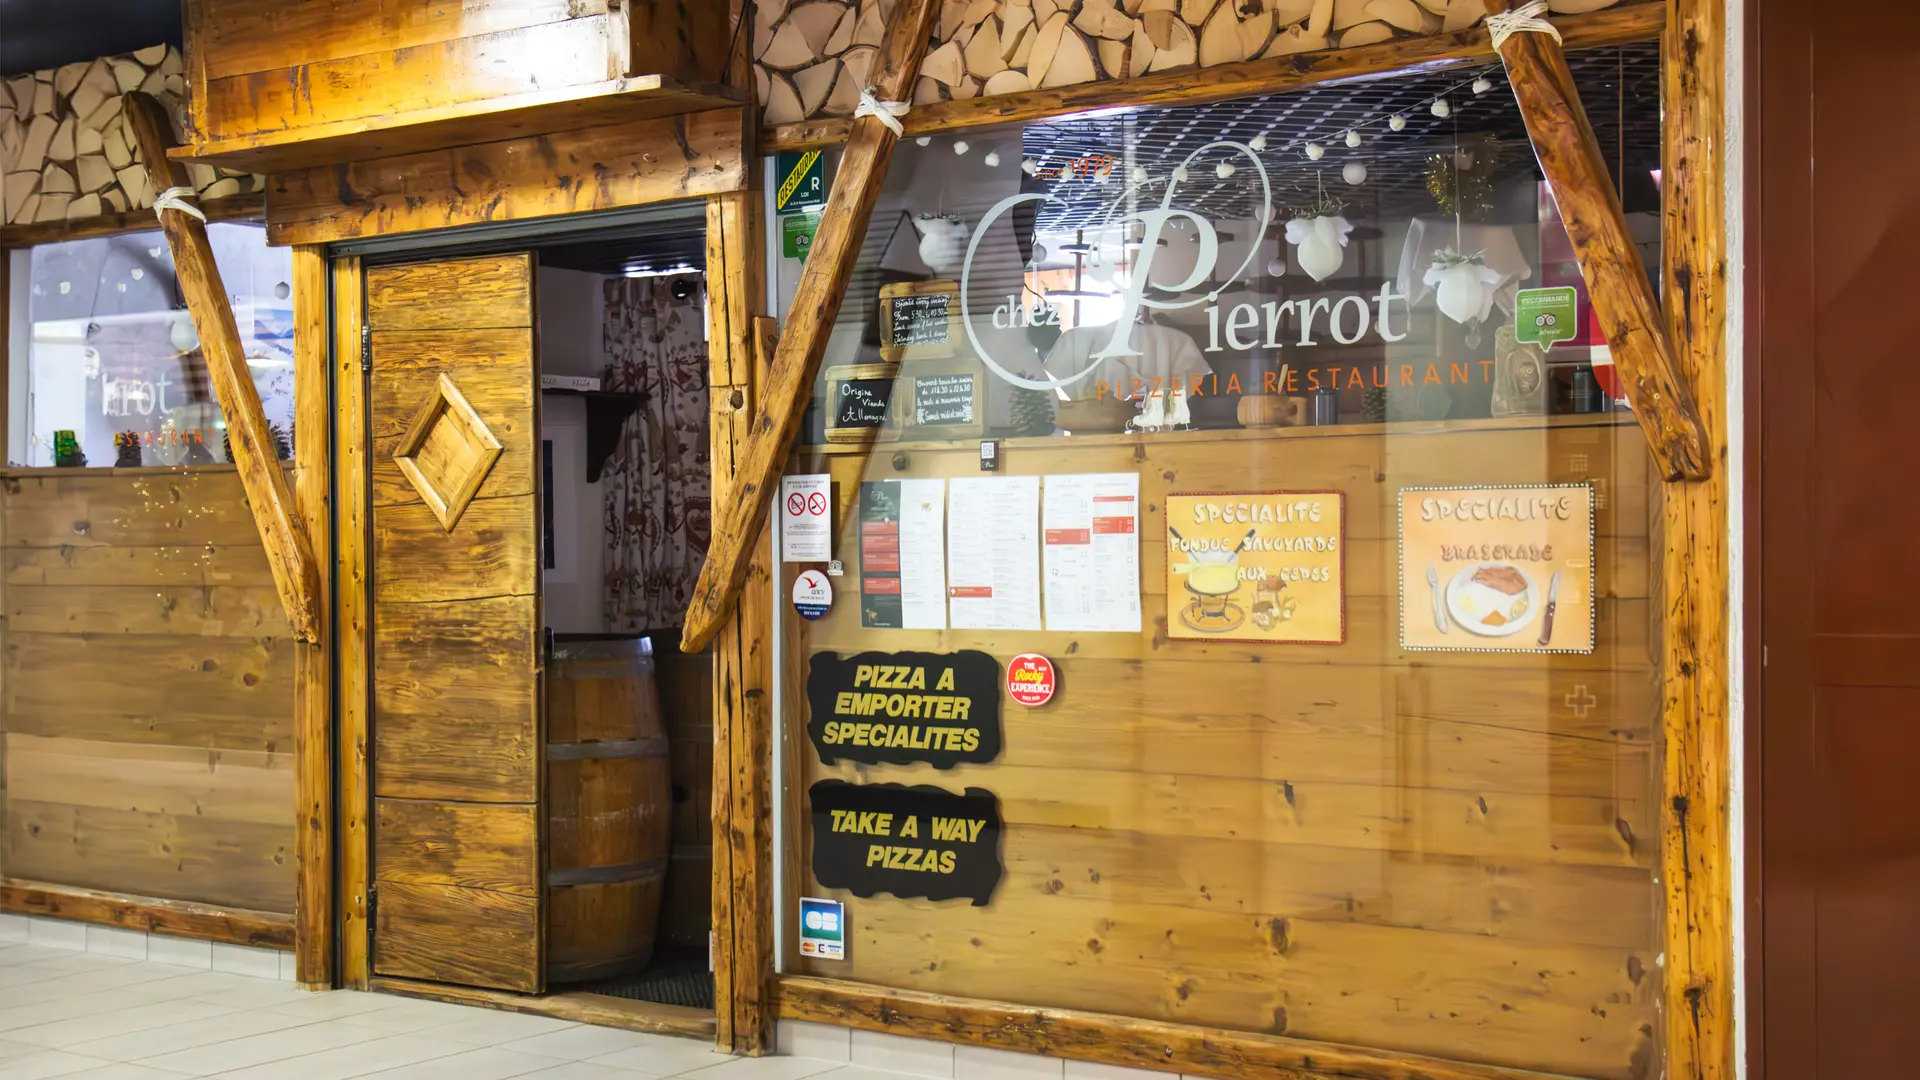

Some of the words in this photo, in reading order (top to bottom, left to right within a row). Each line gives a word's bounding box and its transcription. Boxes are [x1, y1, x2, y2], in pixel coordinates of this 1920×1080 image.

[779, 149, 821, 207] RESTAURAN
[1069, 154, 1113, 179] 1979
[811, 177, 820, 191] R
[991, 295, 1062, 330] chez
[1088, 141, 1408, 359] Pierrot
[842, 383, 873, 400] Origine
[1097, 371, 1243, 400] PIZZERIA
[1263, 361, 1495, 393] RESTAURANT
[1194, 502, 1323, 524] SPECIALITE
[1421, 496, 1572, 522] SPECIALITE
[1170, 537, 1230, 553] FONDUE
[1242, 536, 1337, 553] SAVOYARDE
[1236, 566, 1268, 581] AUX
[1280, 566, 1330, 582] CEPES
[854, 665, 926, 690] PIZZA
[936, 668, 955, 691] A
[1015, 669, 1044, 684] Rocky
[834, 692, 972, 720] EMPORTER
[822, 721, 981, 752] SPECIALITES
[830, 810, 894, 836] TAKE
[899, 815, 918, 838] A
[931, 817, 987, 843] WAY
[866, 845, 957, 874] PIZZAS
